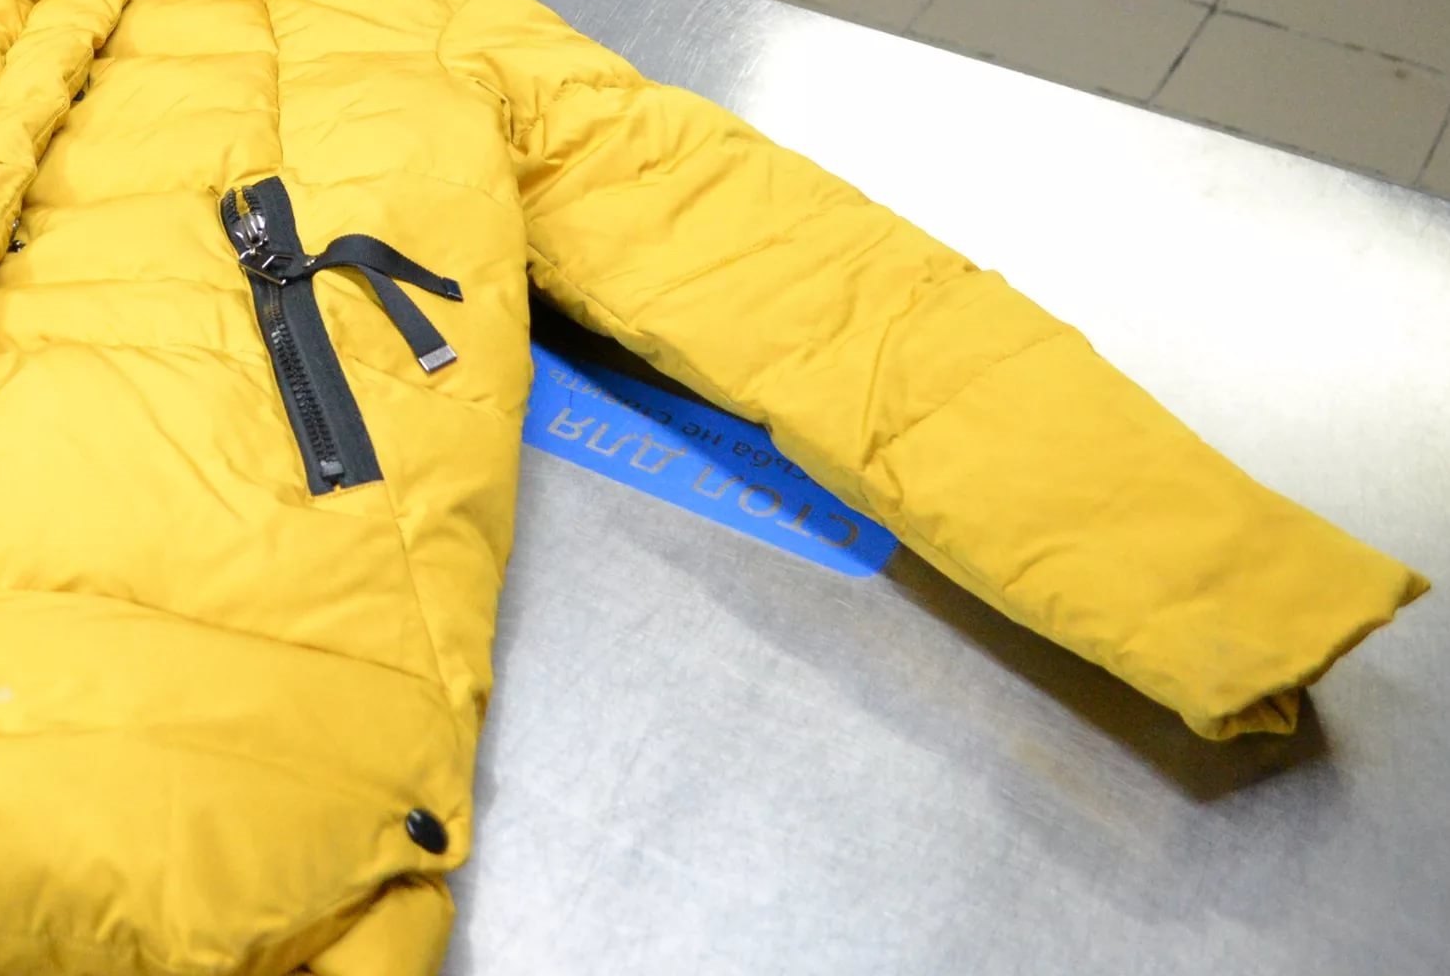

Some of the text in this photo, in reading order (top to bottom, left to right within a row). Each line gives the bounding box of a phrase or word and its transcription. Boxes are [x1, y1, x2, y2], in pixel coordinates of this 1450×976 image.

[681, 421, 724, 446] не
[547, 407, 860, 548] СТОЛ ДЛЯ
